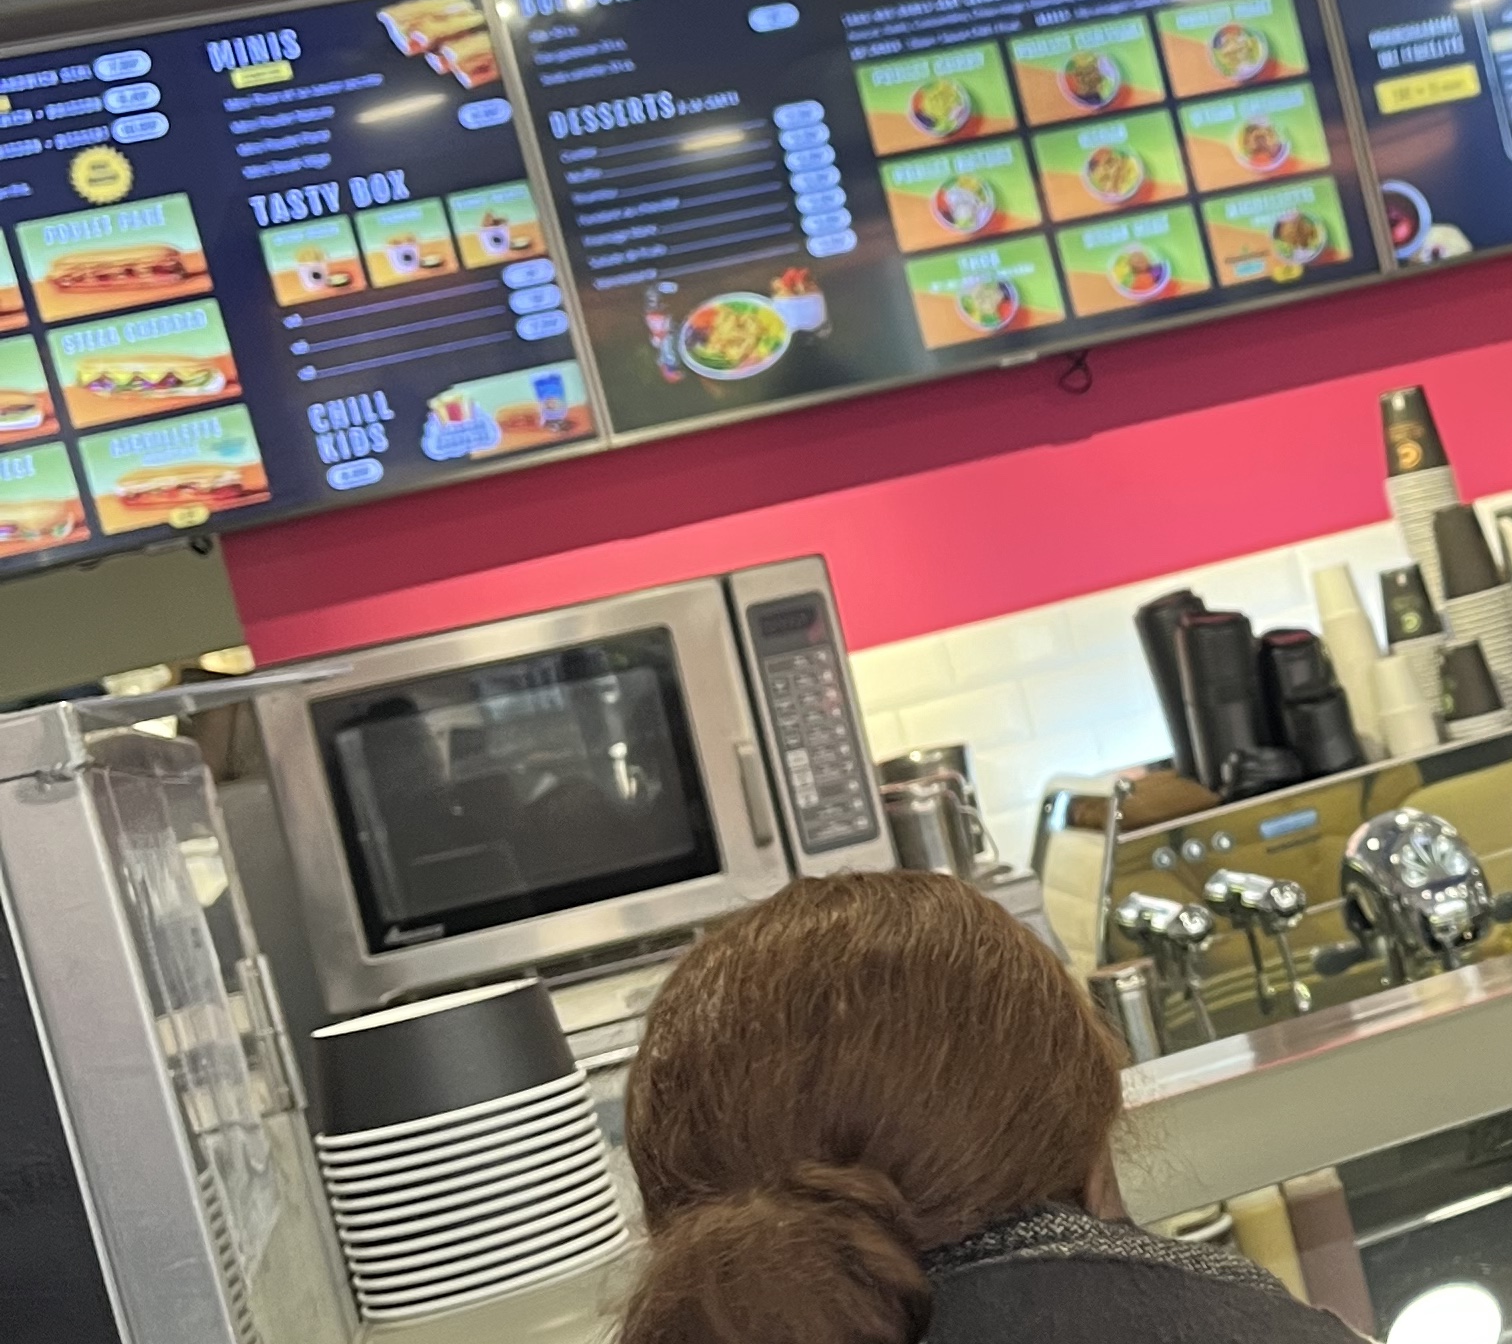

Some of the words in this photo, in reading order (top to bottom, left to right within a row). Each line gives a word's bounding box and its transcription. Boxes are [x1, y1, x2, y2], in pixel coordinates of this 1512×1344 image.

[206, 29, 301, 72] MINIS
[548, 90, 677, 140] DESSERTS
[249, 181, 341, 227] TASTY
[348, 169, 411, 209] BOX
[307, 390, 394, 434] CHILL
[315, 423, 389, 464] KIDS
